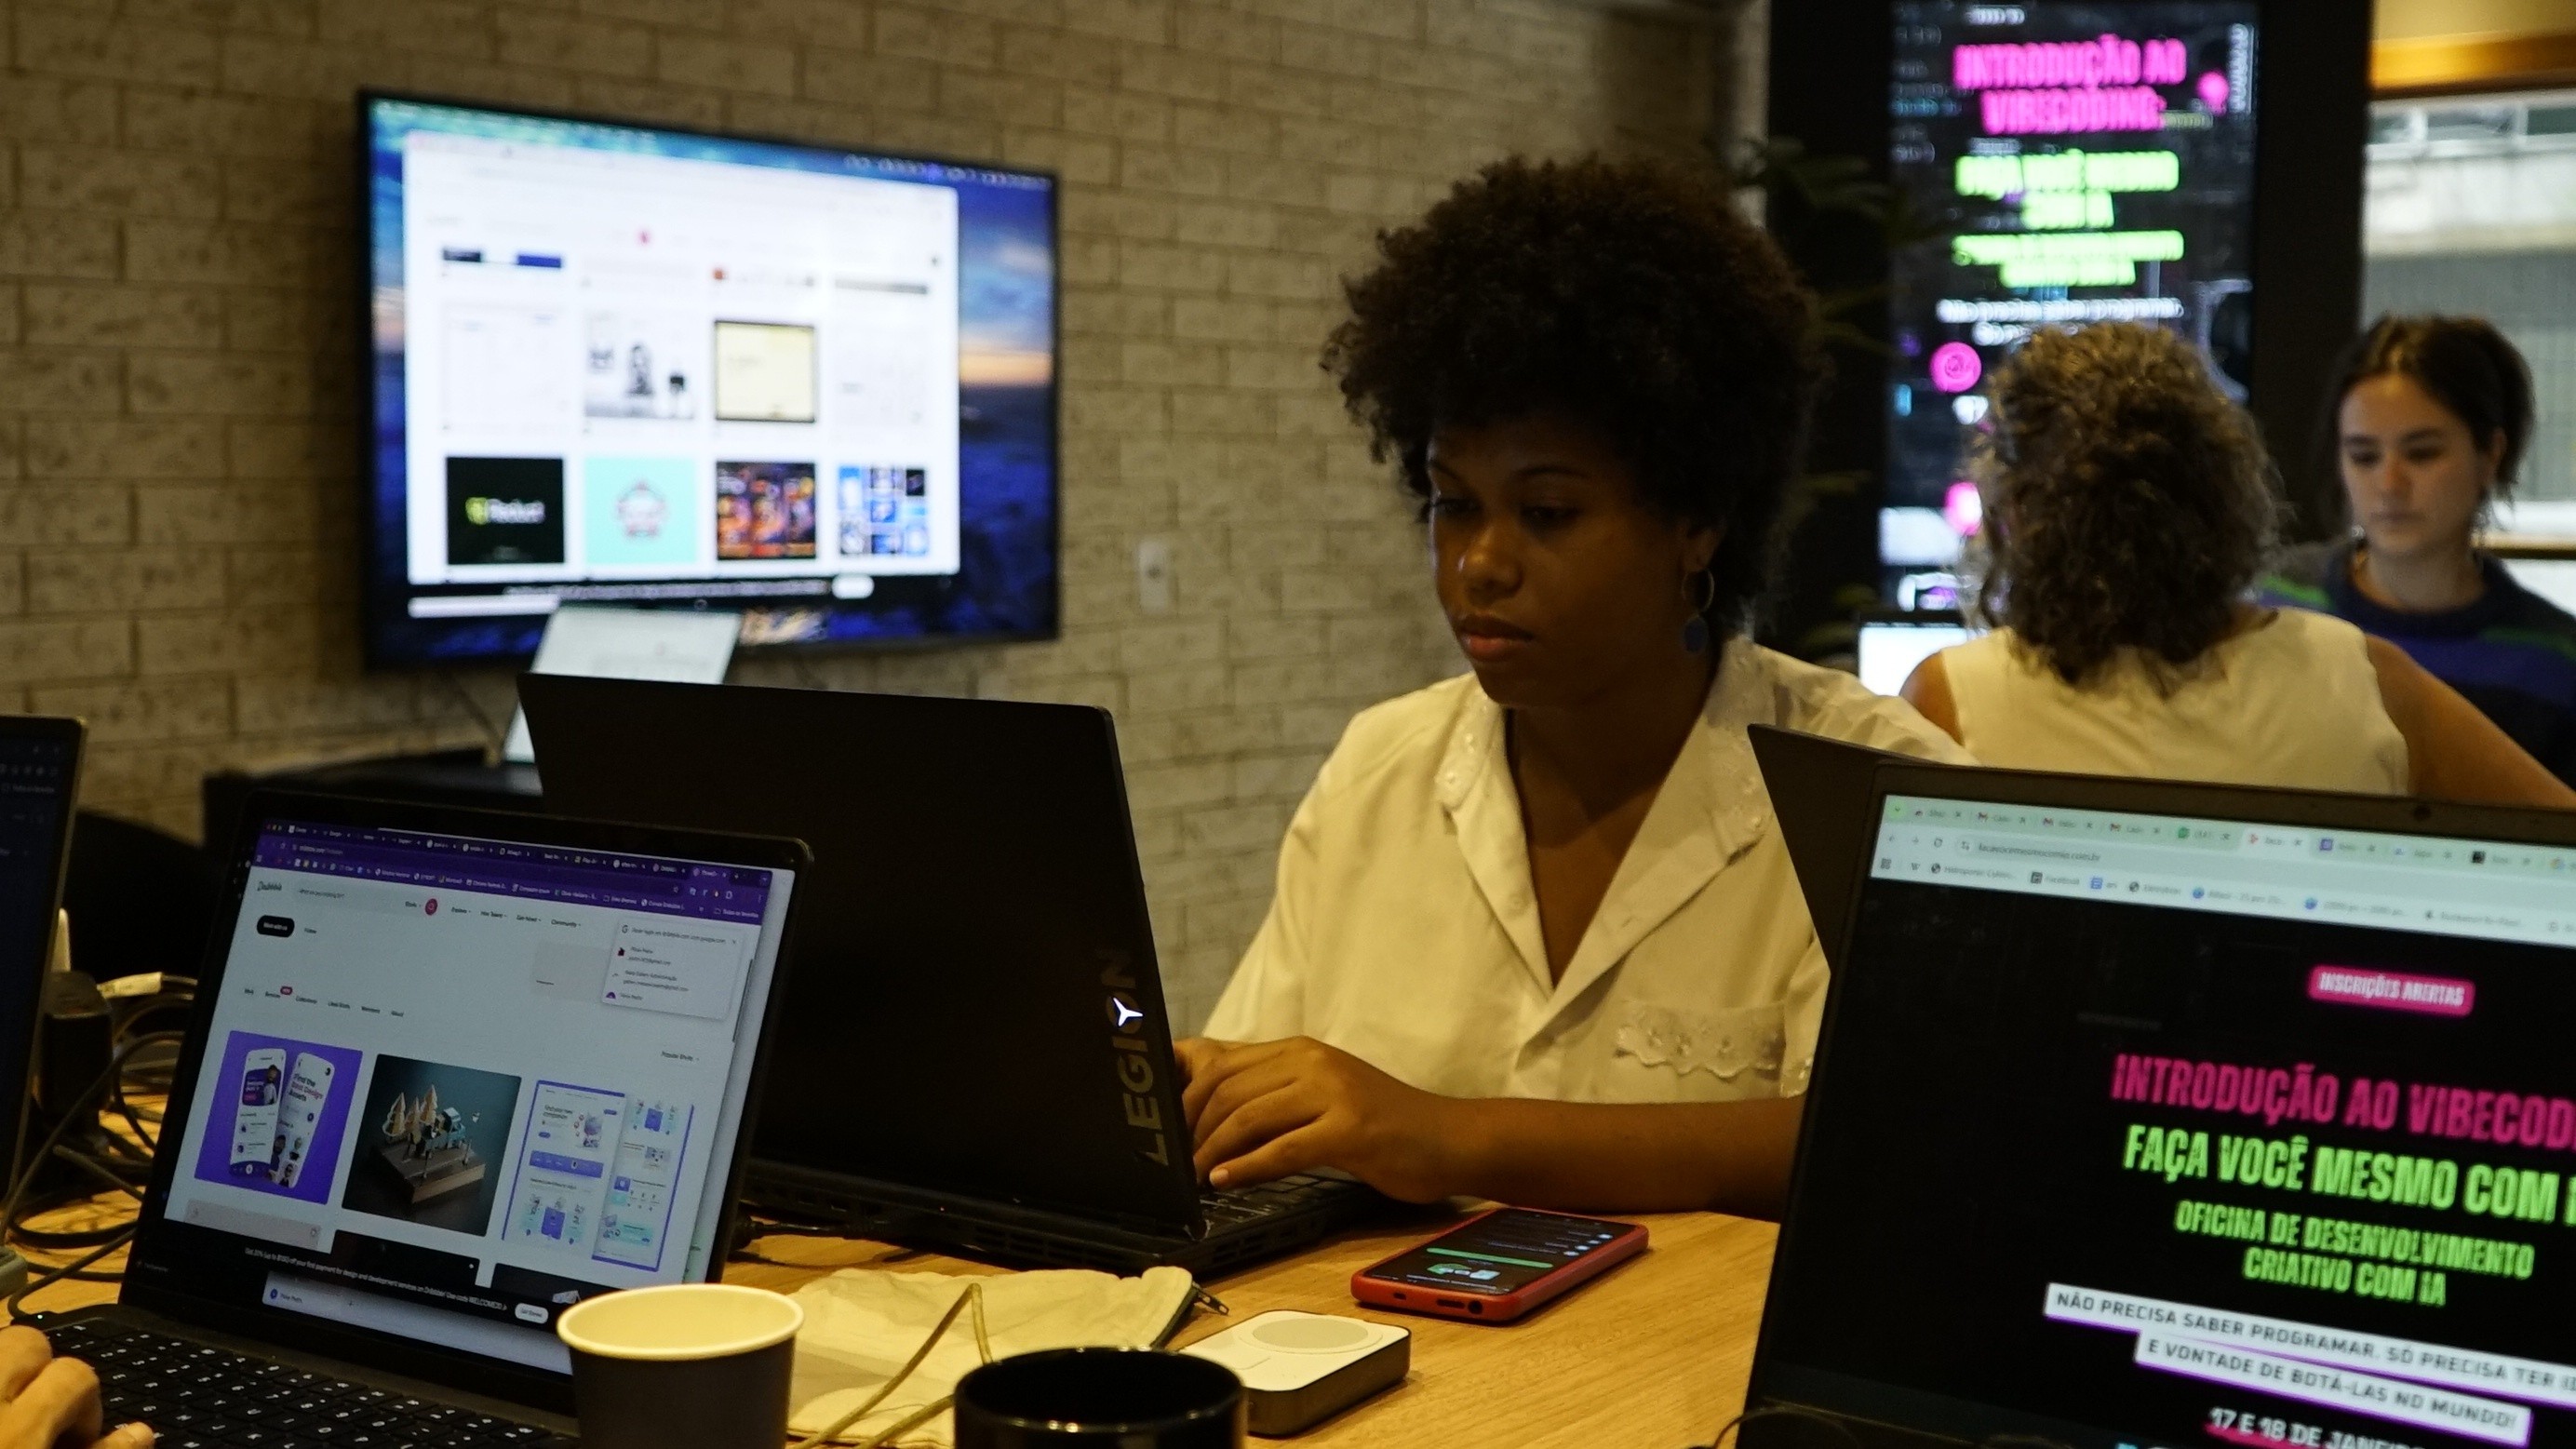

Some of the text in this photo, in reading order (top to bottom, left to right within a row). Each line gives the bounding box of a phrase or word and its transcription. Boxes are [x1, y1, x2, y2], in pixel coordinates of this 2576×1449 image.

[2111, 1053, 2576, 1152] INTRODUÇÃO AO VIBECOD
[2122, 1123, 2209, 1183] FAÇA
[2217, 1134, 2310, 1190] VOCÊ
[2310, 1145, 2459, 1210] MESMO
[2463, 1163, 2560, 1225] COM
[2174, 1199, 2536, 1280] OFICINA DE DESENVOLVIMENTO
[2242, 1246, 2448, 1308] CRIATIVO COM IA
[2057, 1292, 2095, 1311] NÃO
[2100, 1298, 2178, 1325] PRECISA
[2182, 1312, 2245, 1336] SABER
[2386, 1345, 2414, 1365] SÓ
[2420, 1351, 2509, 1380] PRECISA
[2514, 1366, 2556, 1387] TER
[2148, 1338, 2160, 1353] E
[2165, 1342, 2254, 1374] VONTADE
[2259, 1363, 2284, 1381] DE
[2290, 1371, 2388, 1402] BOTÁ-LAS
[2394, 1391, 2424, 1409] NO
[2209, 1406, 2237, 1429] 17
[2237, 1413, 2256, 1434] E
[2258, 1416, 2287, 1440] 18
[2288, 1422, 2323, 1446] DE
